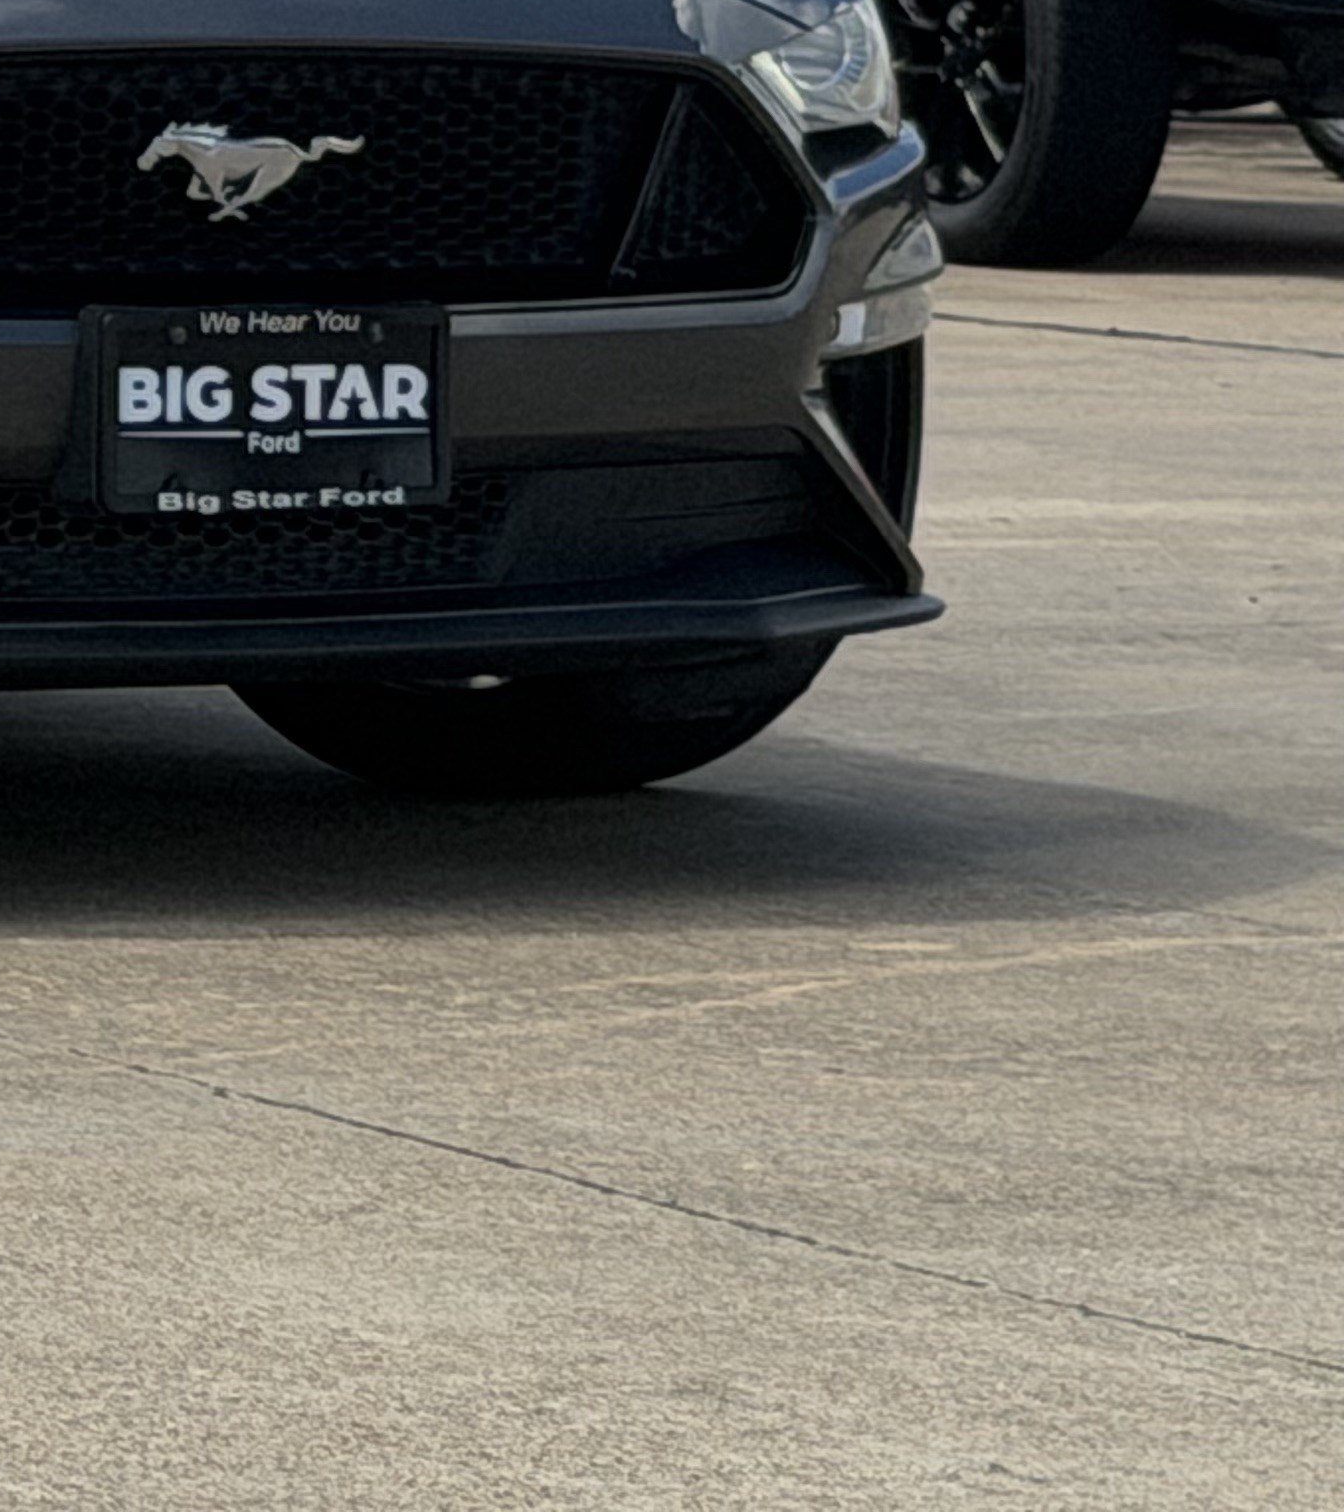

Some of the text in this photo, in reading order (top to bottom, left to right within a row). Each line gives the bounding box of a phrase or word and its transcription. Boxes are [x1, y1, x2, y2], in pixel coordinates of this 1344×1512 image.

[199, 308, 361, 334] We Hear You
[118, 362, 431, 422] BIG STAR
[246, 431, 302, 455] Ford
[157, 486, 406, 516] Big Star Ford
